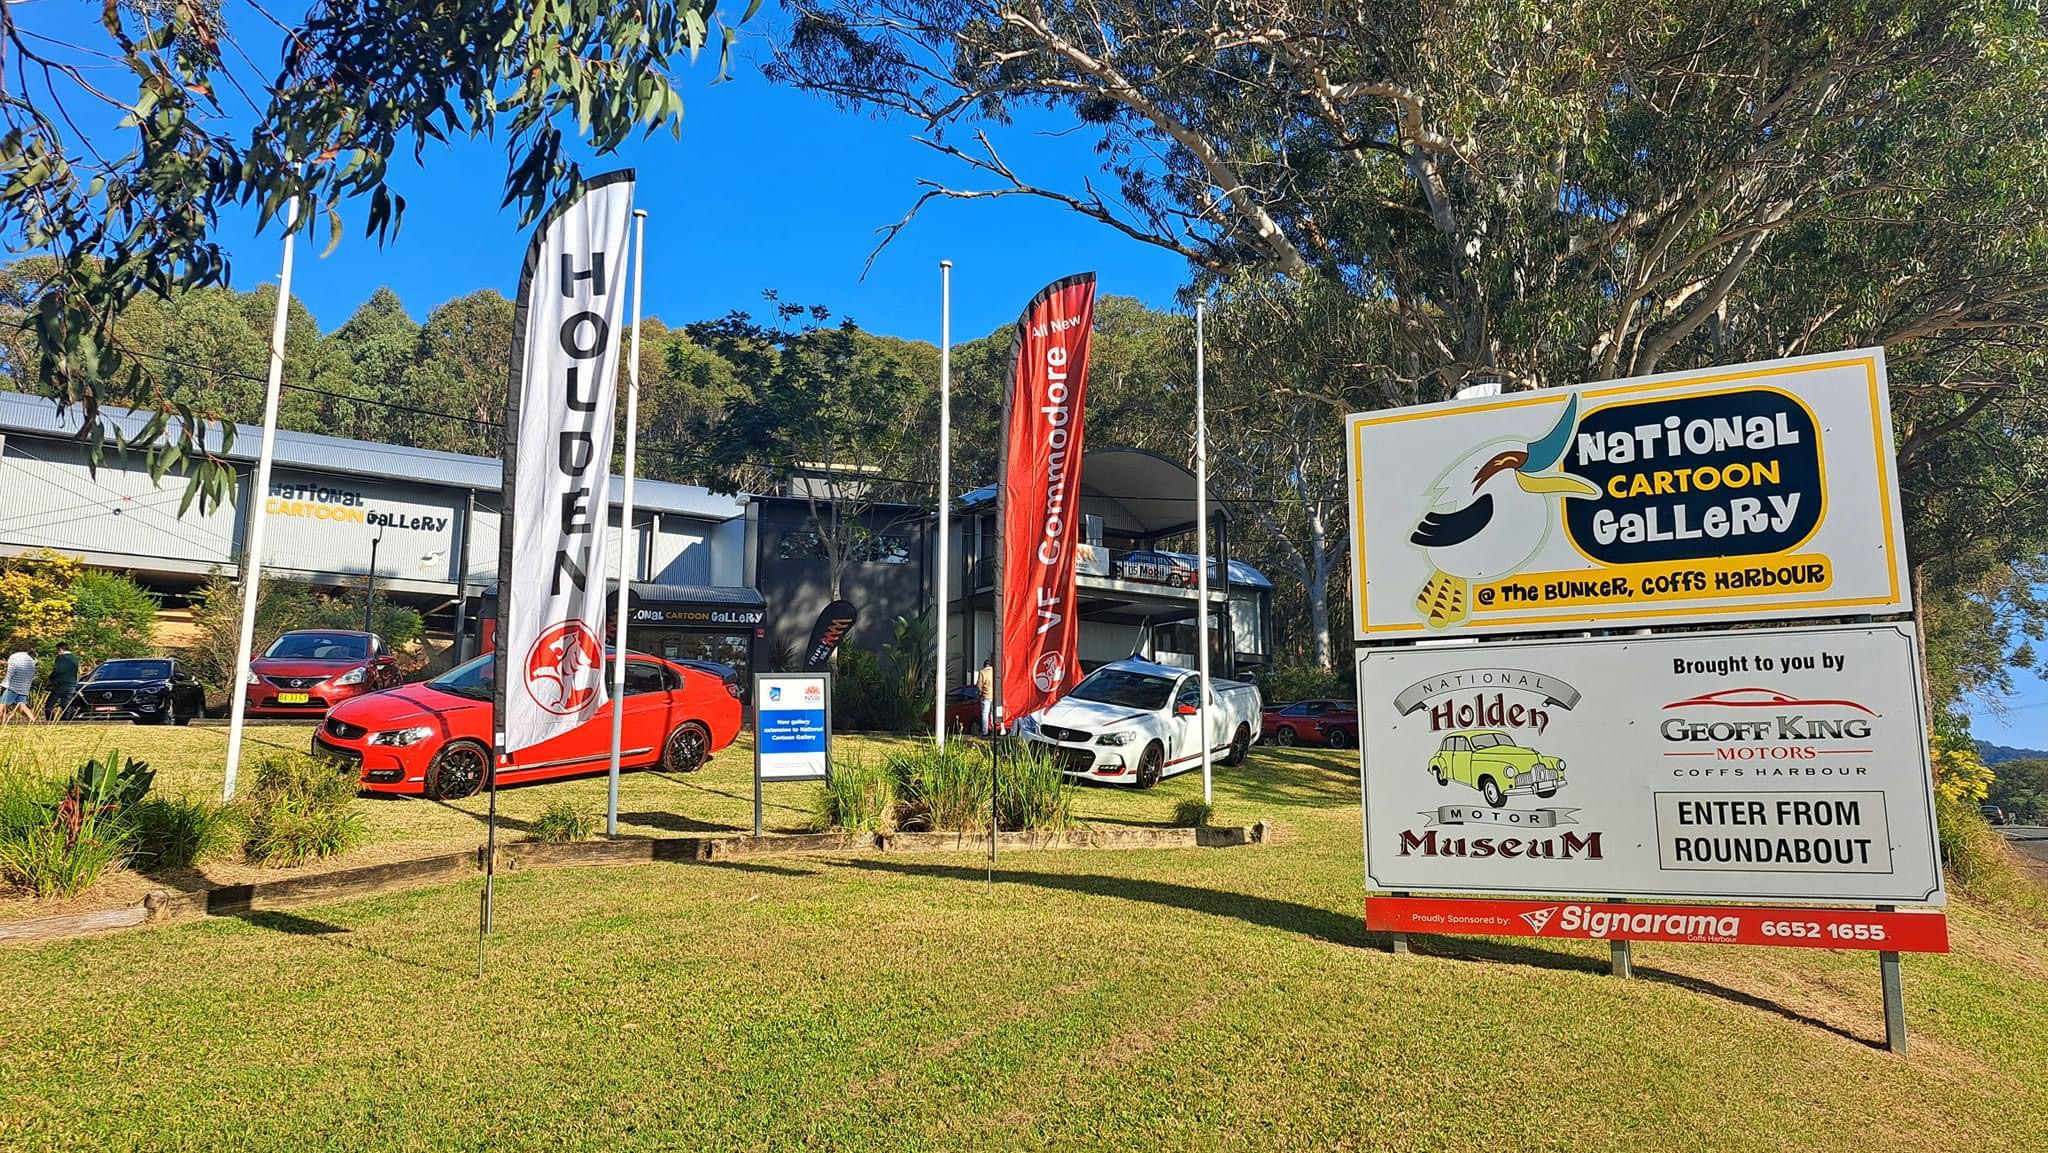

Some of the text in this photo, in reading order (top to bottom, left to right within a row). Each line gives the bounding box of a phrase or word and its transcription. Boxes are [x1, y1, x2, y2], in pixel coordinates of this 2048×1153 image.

[1032, 315, 1080, 340] All New
[551, 252, 609, 597] HOLDEN
[1037, 346, 1068, 635] VF Commodore
[1607, 460, 1781, 499] CARTOON
[265, 497, 365, 524] CARTOON
[1478, 588, 1495, 605] @
[665, 611, 710, 620] CARTOON
[1673, 652, 1844, 676] Brought to you by
[1422, 673, 1544, 694] NATIONAL
[1429, 693, 1550, 736] Holden
[1660, 715, 1872, 742] GEOFF KING
[1716, 746, 1817, 761] MOTORS
[1673, 767, 1867, 777] COFFS HARBOUR
[1450, 809, 1541, 824] MOTOR
[1678, 801, 1861, 826] ENTER FROM
[1674, 837, 1872, 864] ROUNDABOUT
[1412, 913, 1511, 926] Proudly Sponsored by:
[1560, 905, 1740, 938] Signarama
[1761, 920, 1886, 940] 6652 1655
[1687, 934, 1737, 943] Coffs Harbour
